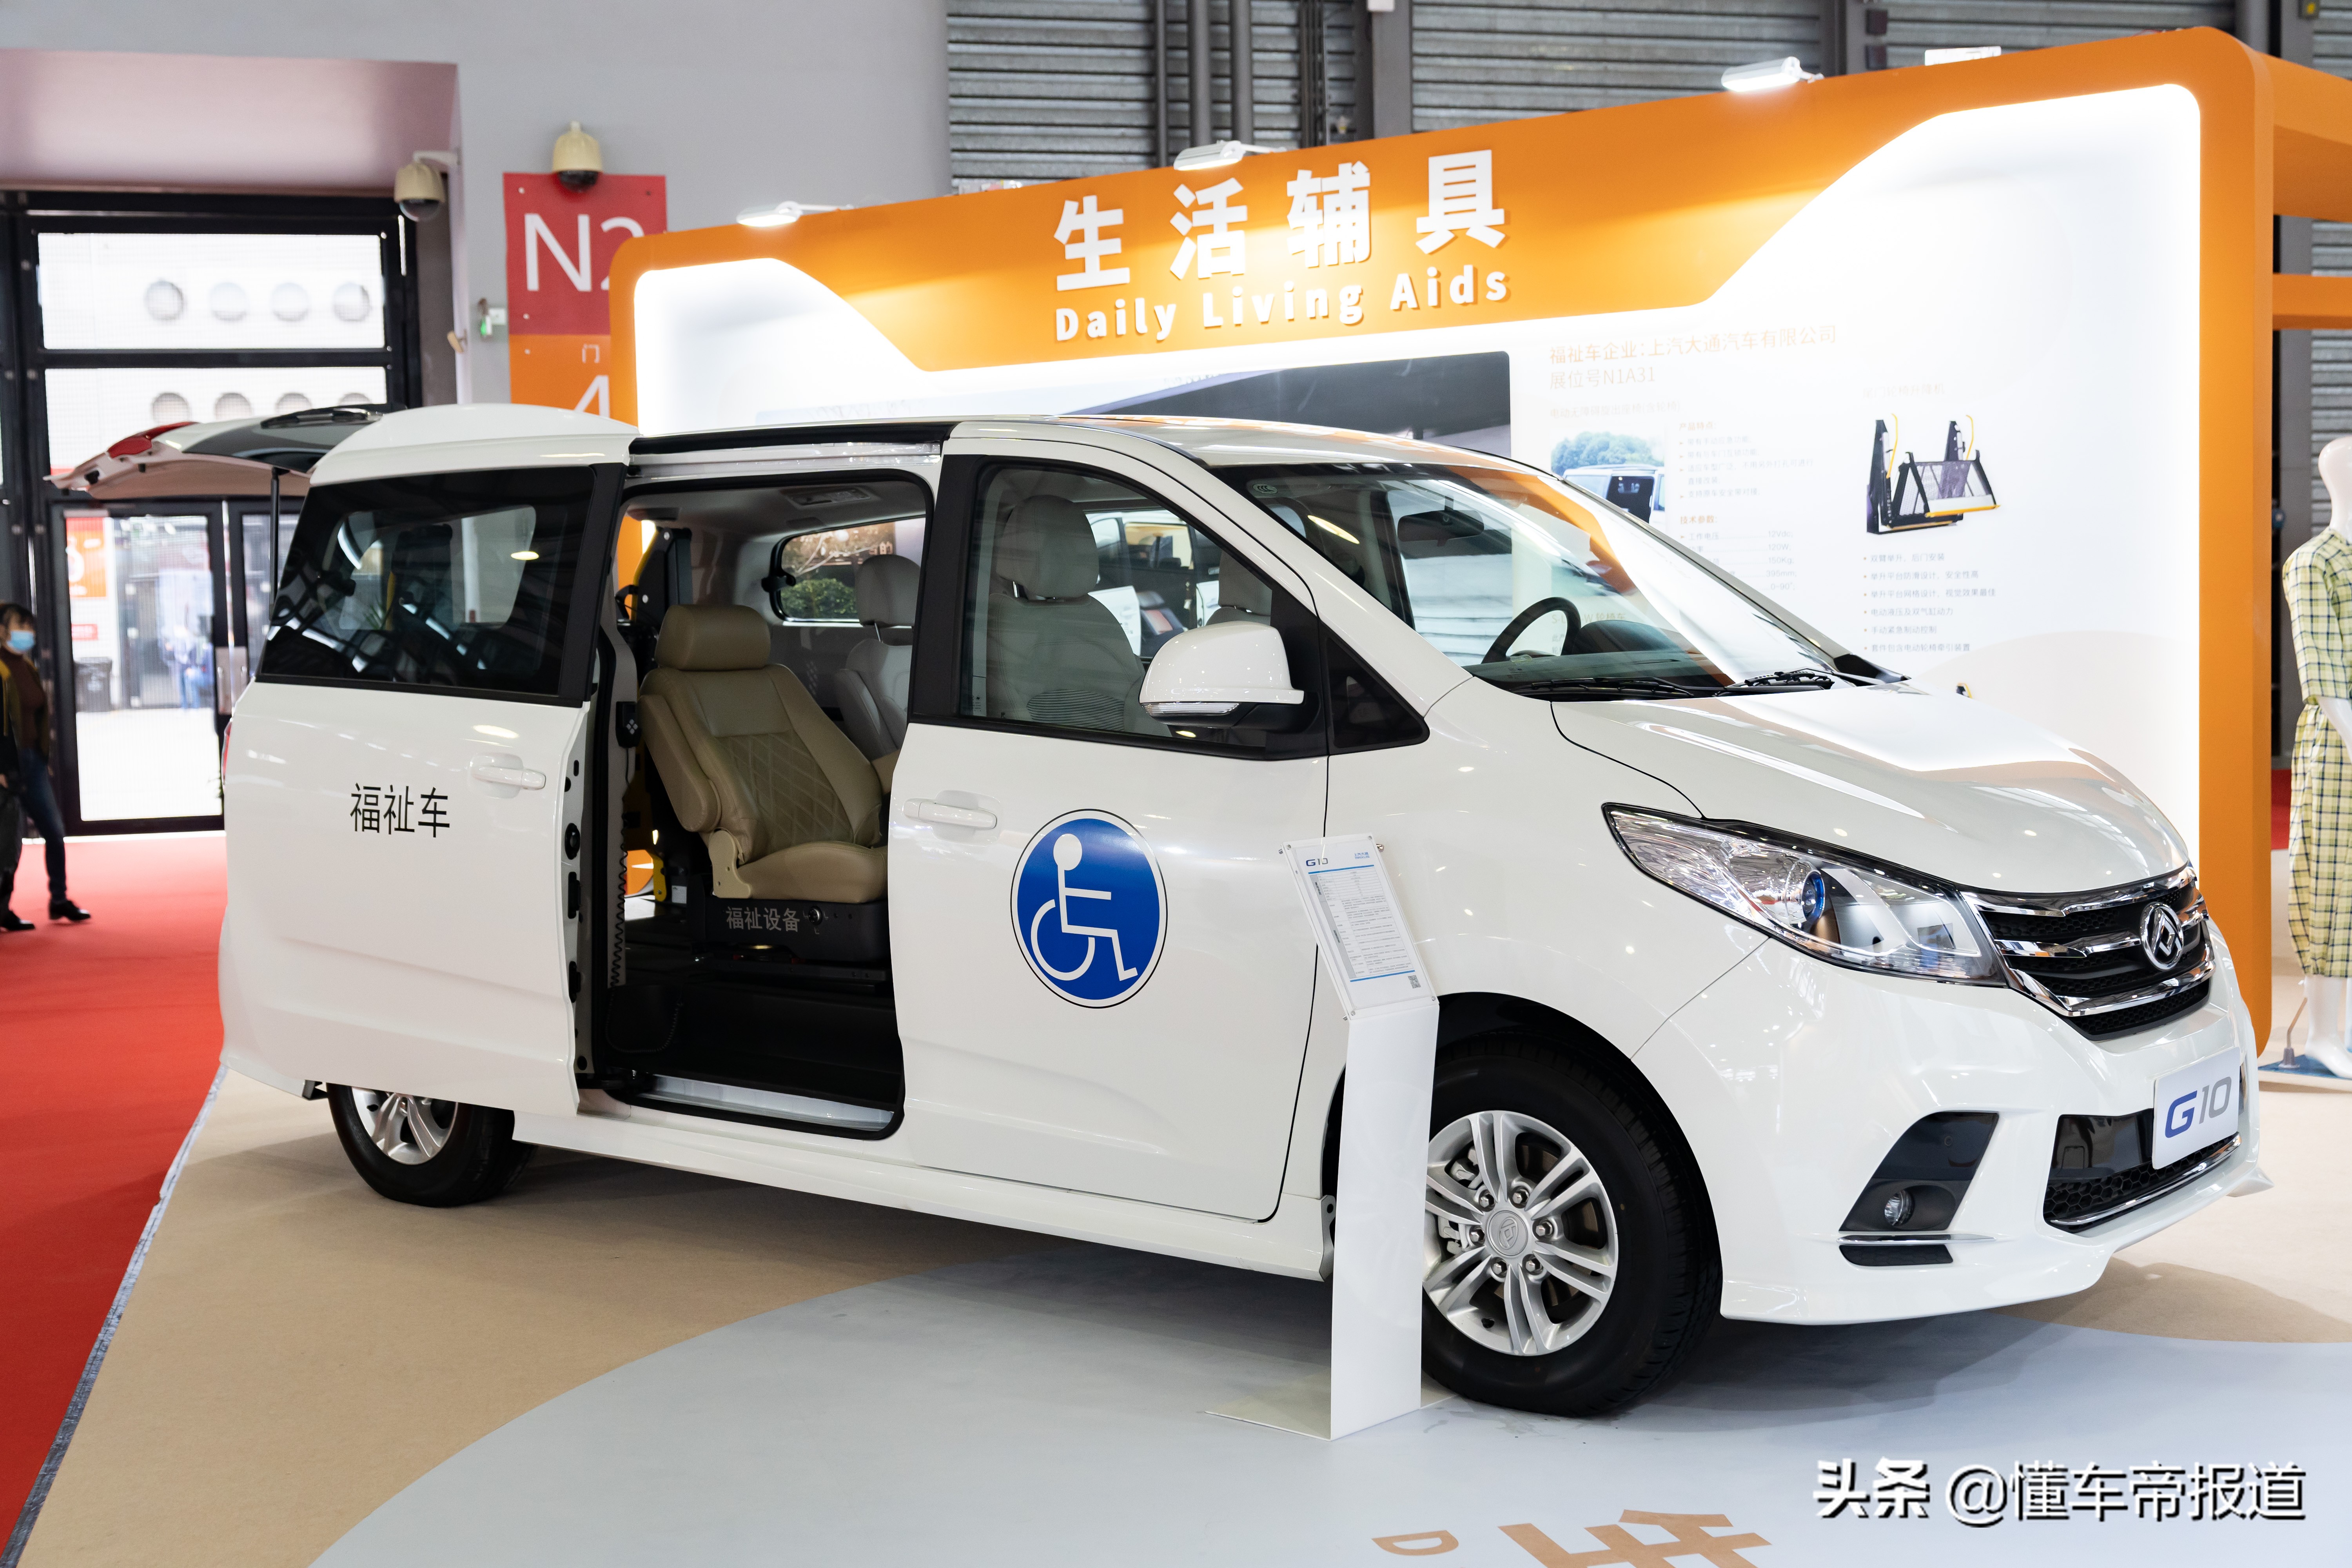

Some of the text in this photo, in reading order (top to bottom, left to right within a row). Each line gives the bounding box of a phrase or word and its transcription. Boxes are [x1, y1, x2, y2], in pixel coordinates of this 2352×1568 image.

[1054, 150, 1506, 291] 生活辅具
[1056, 265, 1508, 341] Daily Living Aids
[582, 343, 600, 363] 门
[1549, 325, 1836, 365] 福祉车企业:上汽大通汽车有限公司
[1550, 366, 1655, 390] 展位号N1A31
[350, 782, 450, 838] 福祉车
[726, 906, 800, 933] 福祉设备
[2165, 1076, 2232, 1138] G10
